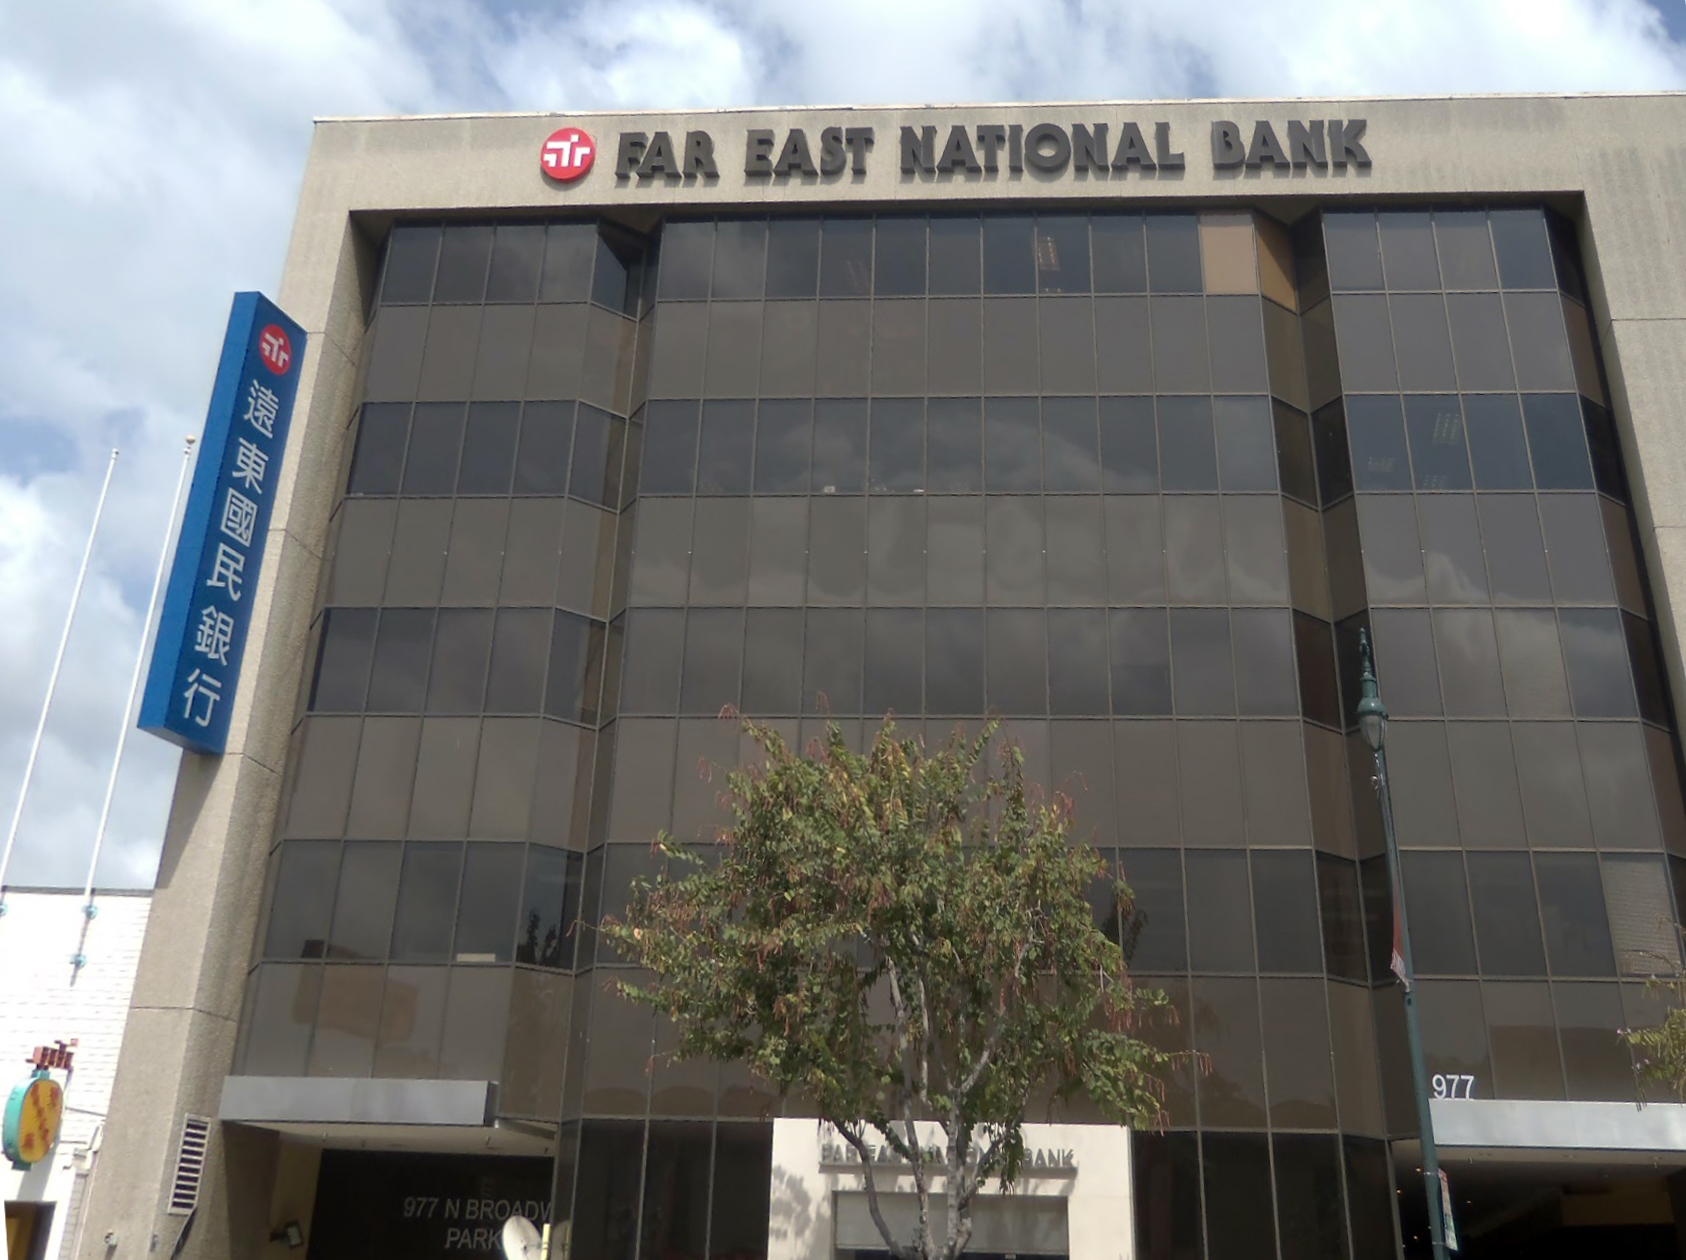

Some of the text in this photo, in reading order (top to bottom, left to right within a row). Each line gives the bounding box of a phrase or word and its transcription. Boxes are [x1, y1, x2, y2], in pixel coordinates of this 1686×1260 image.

[615, 119, 1372, 179] FAR EAST NATIONAL BANK
[183, 379, 279, 727] 遠東國民銀行
[1432, 1074, 1474, 1100] 977
[1022, 1147, 1075, 1169] BANK
[403, 1197, 439, 1218] 977
[444, 1199, 460, 1219] N
